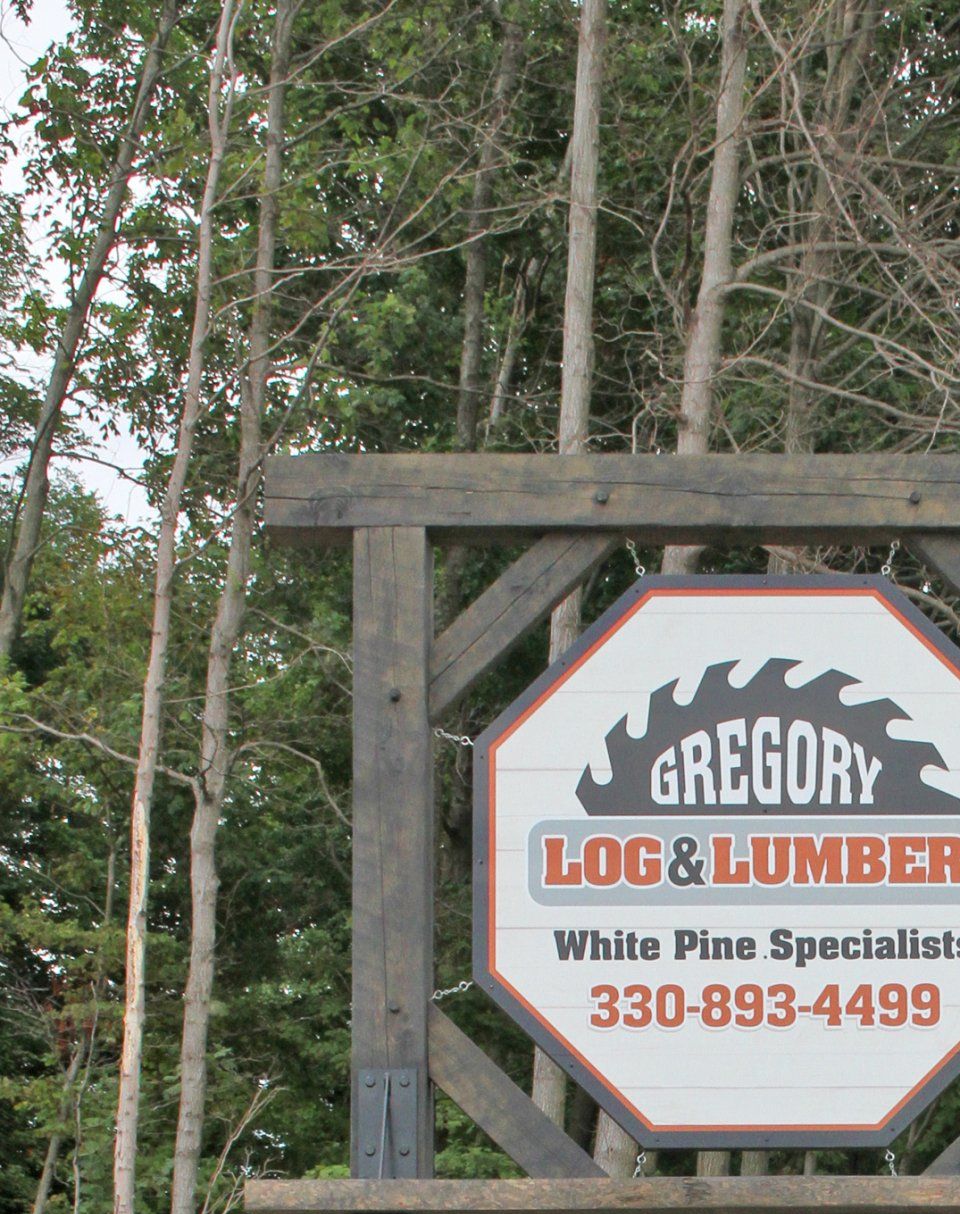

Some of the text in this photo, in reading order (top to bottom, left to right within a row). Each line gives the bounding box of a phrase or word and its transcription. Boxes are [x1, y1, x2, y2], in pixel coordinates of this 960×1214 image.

[650, 715, 883, 805] GREGORY
[553, 929, 661, 960] White
[674, 929, 757, 960] Pine
[589, 983, 942, 1028] 330-893-4499
